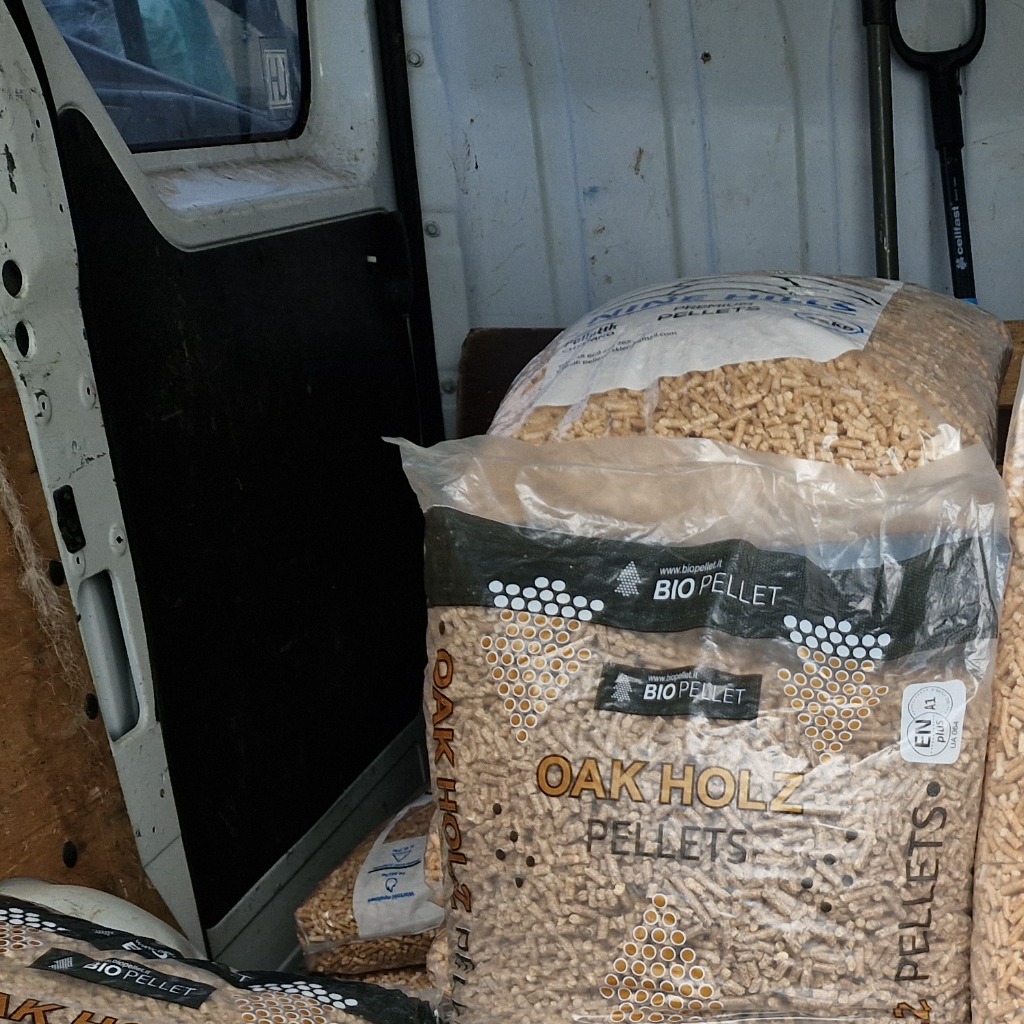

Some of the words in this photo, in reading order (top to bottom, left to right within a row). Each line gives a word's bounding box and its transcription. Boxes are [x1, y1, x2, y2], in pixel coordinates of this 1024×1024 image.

[952, 205, 964, 255] cellfast
[657, 304, 762, 321] PELLETS
[660, 559, 723, 575] www.biopellet.it
[648, 671, 699, 681] www.biopellet.it
[432, 648, 455, 769] OAK
[924, 697, 936, 711] A1
[914, 719, 932, 748] EN
[935, 720, 947, 743] plus
[536, 755, 644, 803] OAK
[660, 762, 805, 815] HOLZ
[436, 776, 472, 913] HOLZ
[586, 817, 748, 865] PELLETS
[895, 805, 948, 983] PELLETS
